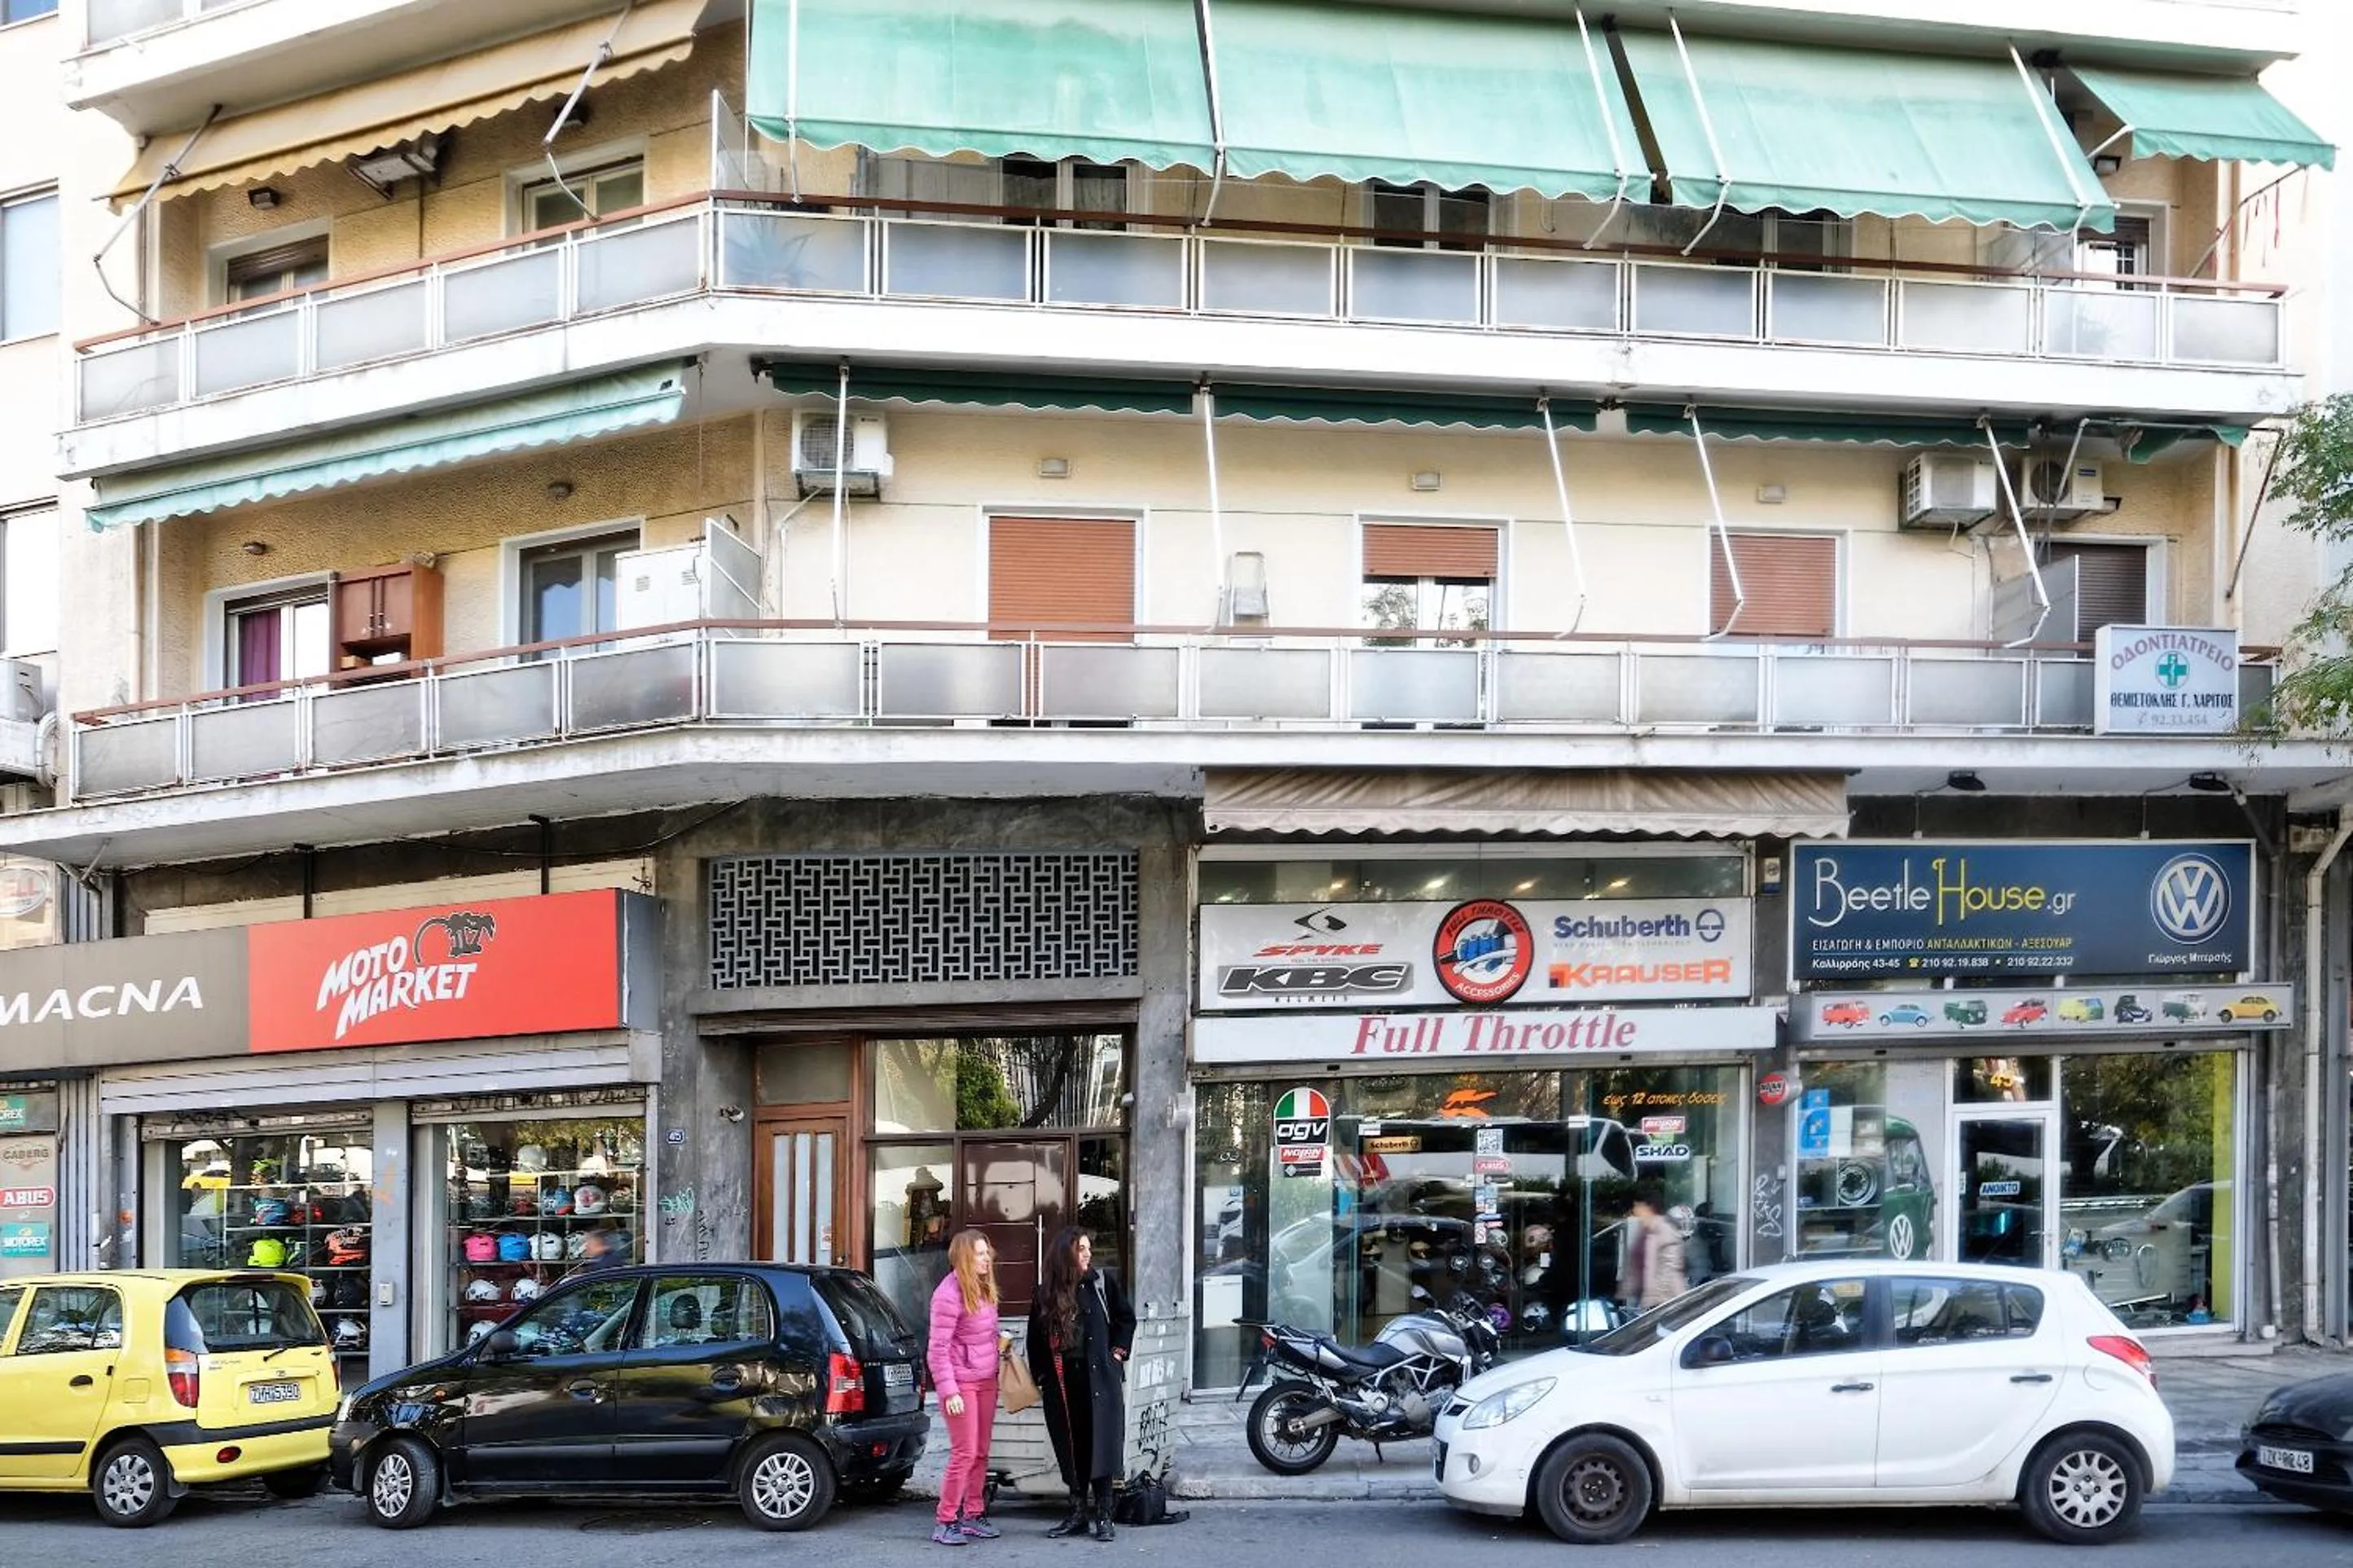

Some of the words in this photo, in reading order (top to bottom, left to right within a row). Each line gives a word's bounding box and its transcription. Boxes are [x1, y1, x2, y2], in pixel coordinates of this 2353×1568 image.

[2111, 634, 2234, 671] ΟΔΟΝΤΙΑΤΡΕΙΟ
[2111, 692, 2176, 708] ΘΕΜΙΣΤΟΚΛΗΣ
[1554, 914, 1690, 938] Schuberth
[1252, 943, 1383, 957] SPYKE
[1813, 939, 1862, 951] ΕΙΣΑΓΩΓΗ
[1864, 939, 1871, 951] &
[1876, 939, 1923, 950] ΕΜΠΟΡΙΟ
[1926, 938, 2012, 949] ΑΝΤΑΛΛΑΚΤΙΚΩΝ
[2021, 938, 2073, 949] ΑΞΕΣΟΥΑΡ
[316, 936, 407, 1011] MOTO
[1556, 959, 1731, 988] KRAUSER
[1812, 958, 1870, 970] Καλλιρρόης
[1872, 958, 1900, 968] 43-45
[1922, 958, 1939, 967] 210
[2008, 958, 2025, 967] 210
[1219, 964, 1409, 993] KBC
[0, 977, 203, 1026] MACNA
[335, 963, 477, 1040] MARKET
[1349, 1017, 1444, 1054] Full
[1463, 1013, 1637, 1051] Throttle
[1631, 1092, 1645, 1105] 12
[1278, 1122, 1327, 1140] agv
[1637, 1146, 1689, 1157] SHAD
[3, 1189, 48, 1205] ABUS
